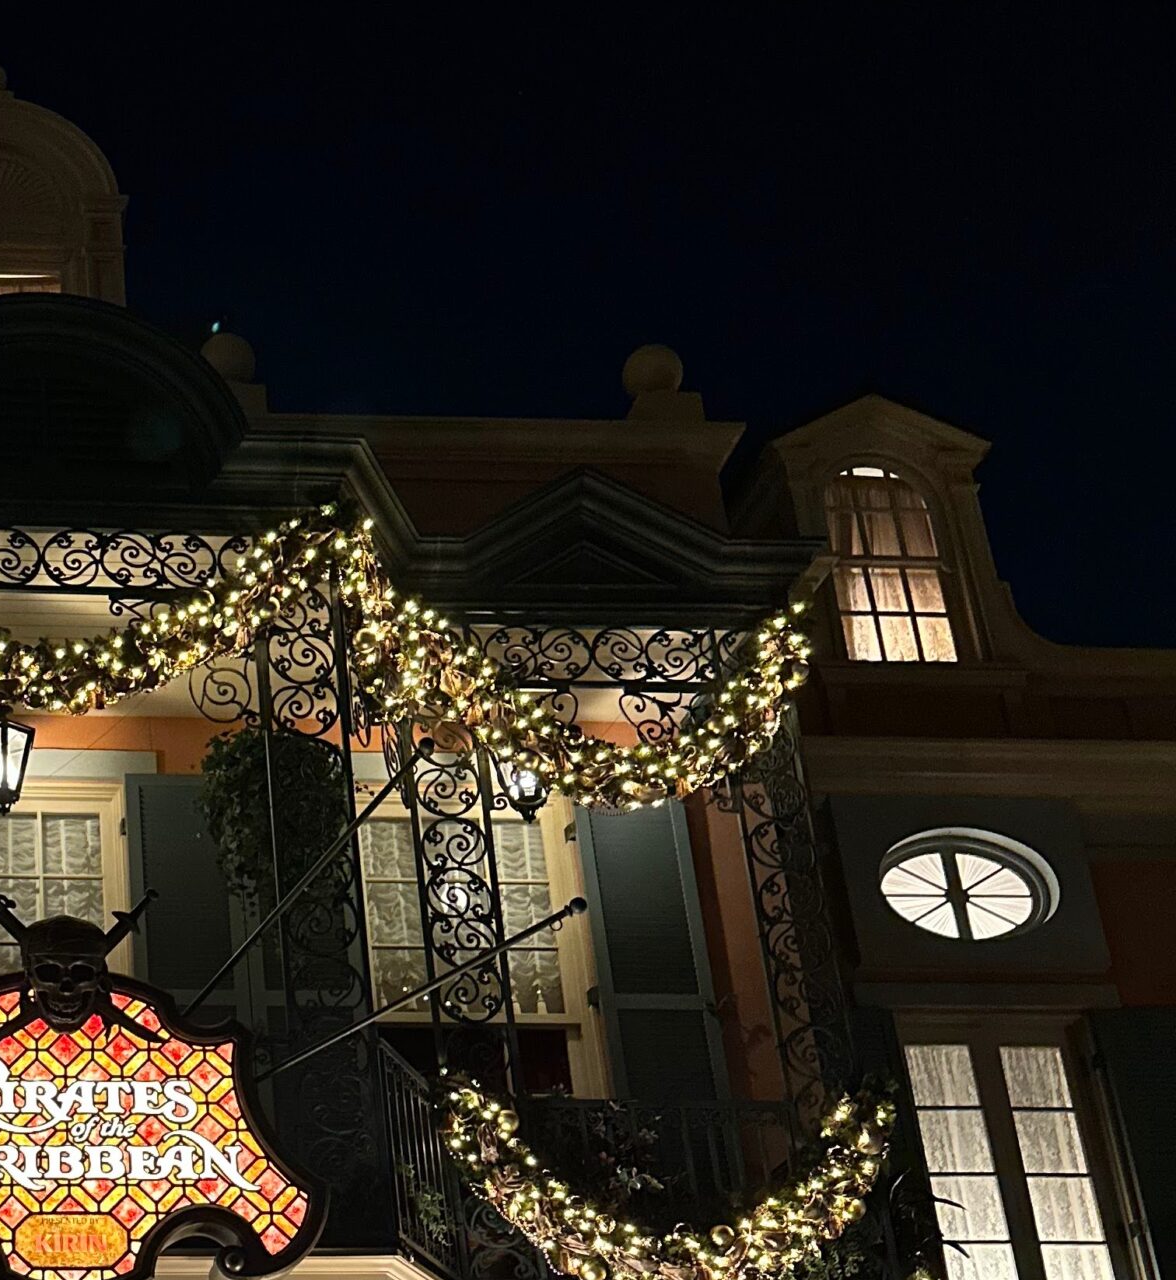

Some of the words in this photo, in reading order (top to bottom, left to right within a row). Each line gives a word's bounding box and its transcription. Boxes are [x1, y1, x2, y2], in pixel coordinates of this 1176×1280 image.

[70, 1115, 100, 1143] of
[100, 1118, 137, 1139] the
[41, 1217, 87, 1225] PRESENTED
[89, 1217, 99, 1225] BY
[35, 1231, 107, 1254] KIRIN
